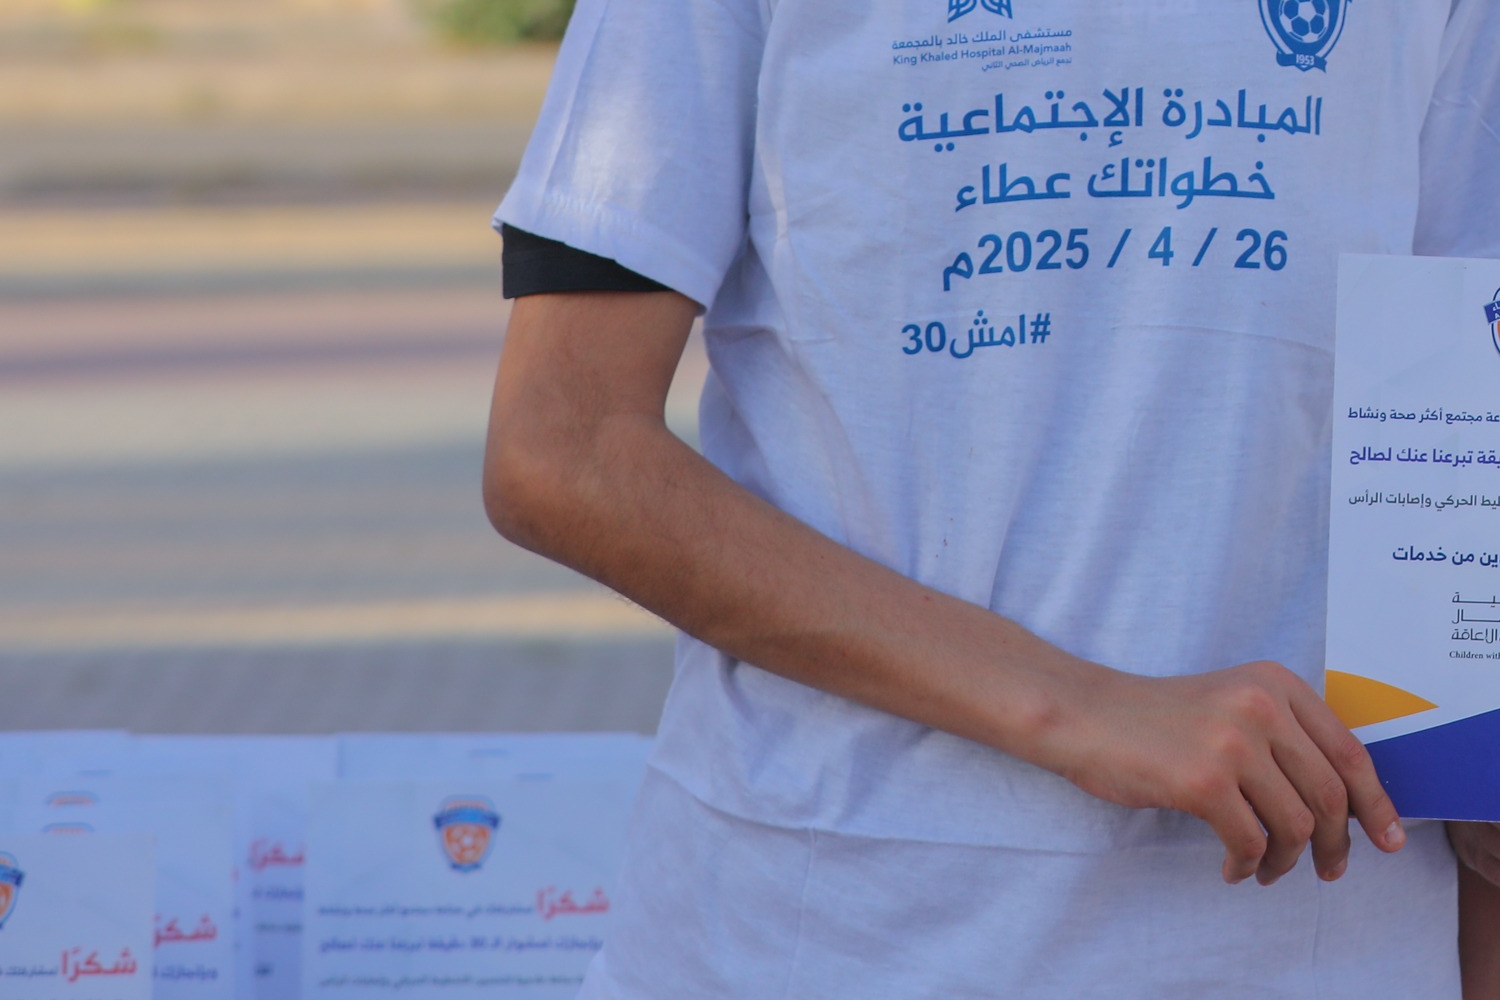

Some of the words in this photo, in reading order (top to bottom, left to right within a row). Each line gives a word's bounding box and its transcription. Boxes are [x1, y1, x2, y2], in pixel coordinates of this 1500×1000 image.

[892, 35, 943, 50] بالمجمعة
[947, 33, 968, 46] خالد
[972, 30, 1006, 43] الملك
[1010, 28, 1072, 43] مستشفى
[893, 54, 917, 66] King
[920, 51, 958, 62] Khaled
[961, 46, 1005, 60] Hospital
[1008, 42, 1072, 56] Al-Majmaah
[1295, 53, 1315, 66] 1953
[897, 86, 1145, 153] الإجتماعية
[1162, 87, 1323, 143] المبادرة
[955, 161, 1072, 213] عطاء
[1087, 156, 1276, 210] خطواتك
[1148, 226, 1175, 267] 4
[1233, 228, 1289, 272] 26
[942, 227, 1090, 291] 2025م
[1347, 406, 1387, 422] ونشاط
[1389, 408, 1416, 420] صحة
[1418, 407, 1443, 424] أكثر
[1445, 410, 1483, 425] مجتمع
[1349, 446, 1392, 465] لصالح
[1396, 448, 1428, 463] عنك
[1432, 448, 1473, 468] تبرعنا
[1348, 489, 1382, 506] الرأس
[1385, 492, 1431, 508] وإصابات
[1434, 495, 1477, 511] الحركي
[1392, 545, 1447, 563] خدمات
[1451, 549, 1475, 566] من
[1449, 650, 1484, 660] Children
